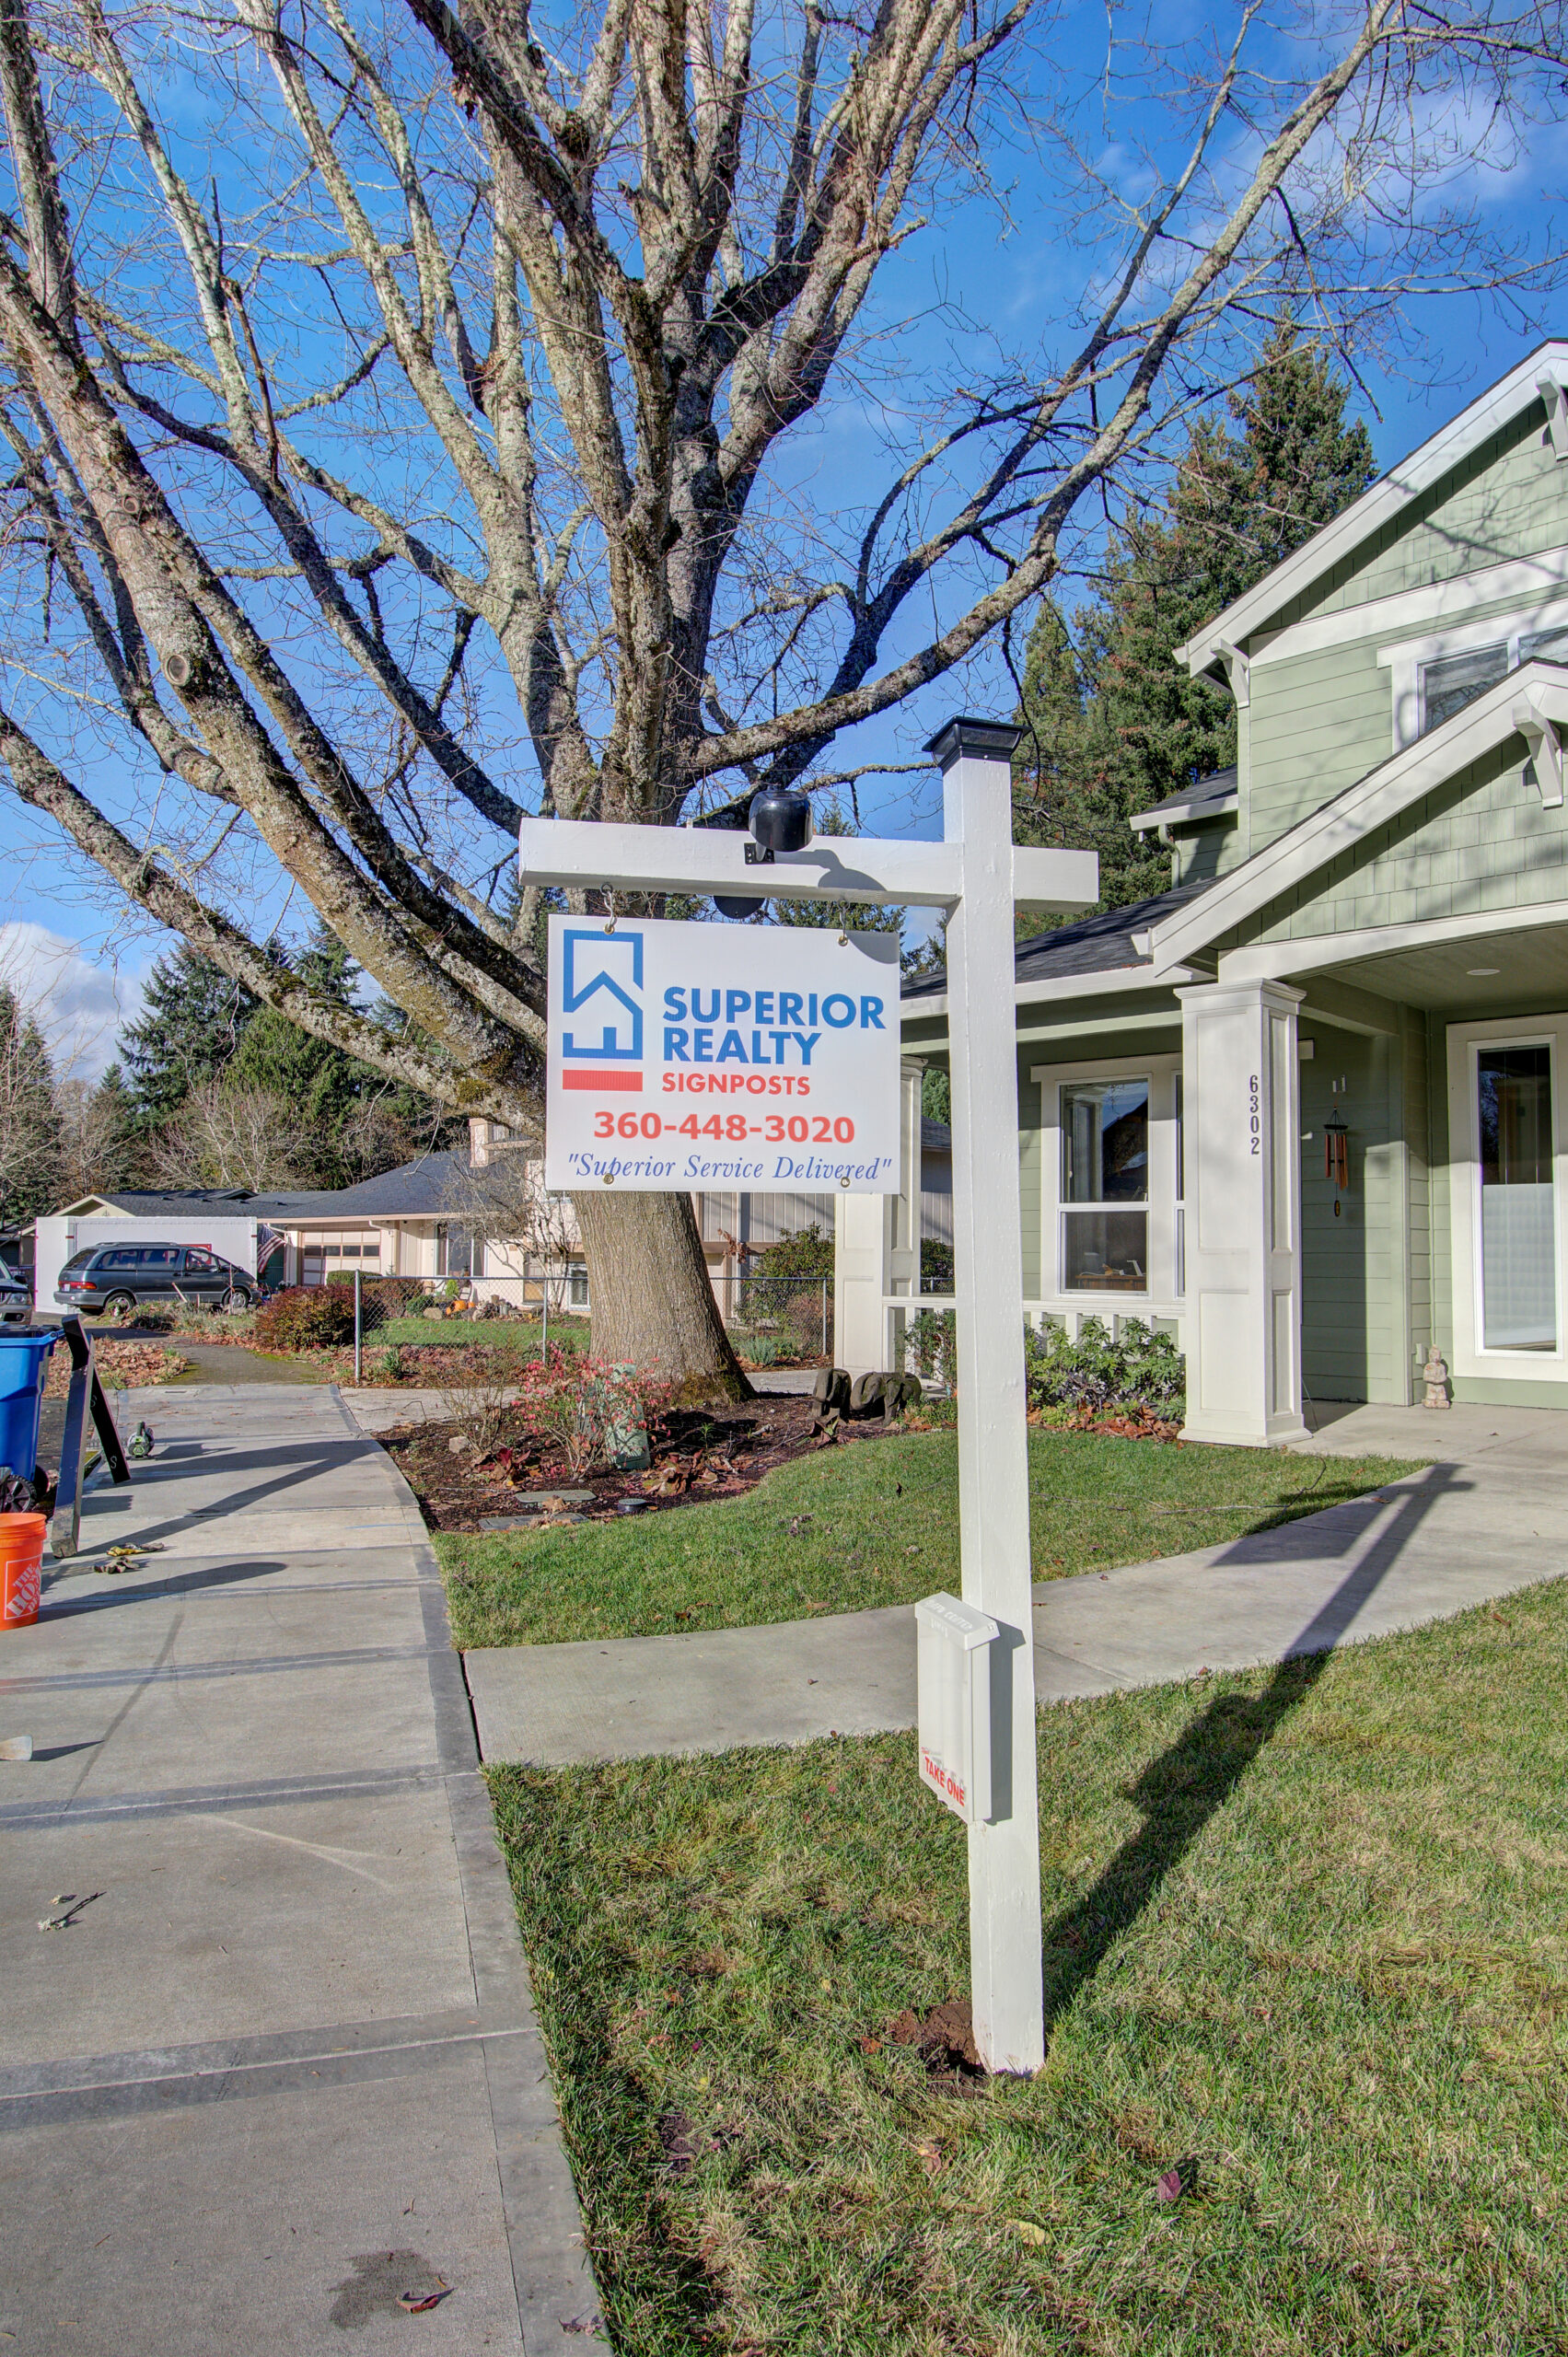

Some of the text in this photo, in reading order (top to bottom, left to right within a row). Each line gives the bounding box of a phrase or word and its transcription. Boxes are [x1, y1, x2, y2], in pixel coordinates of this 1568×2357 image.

[662, 986, 887, 1029] SUPERIOR
[662, 1027, 822, 1066] REALTY
[661, 1072, 811, 1097] SIGNPOSTS
[593, 1110, 855, 1144] 360-448-3020
[1249, 1074, 1260, 1155] 6302
[684, 1155, 763, 1178] Service
[924, 1755, 965, 1808] TAKE ONE
